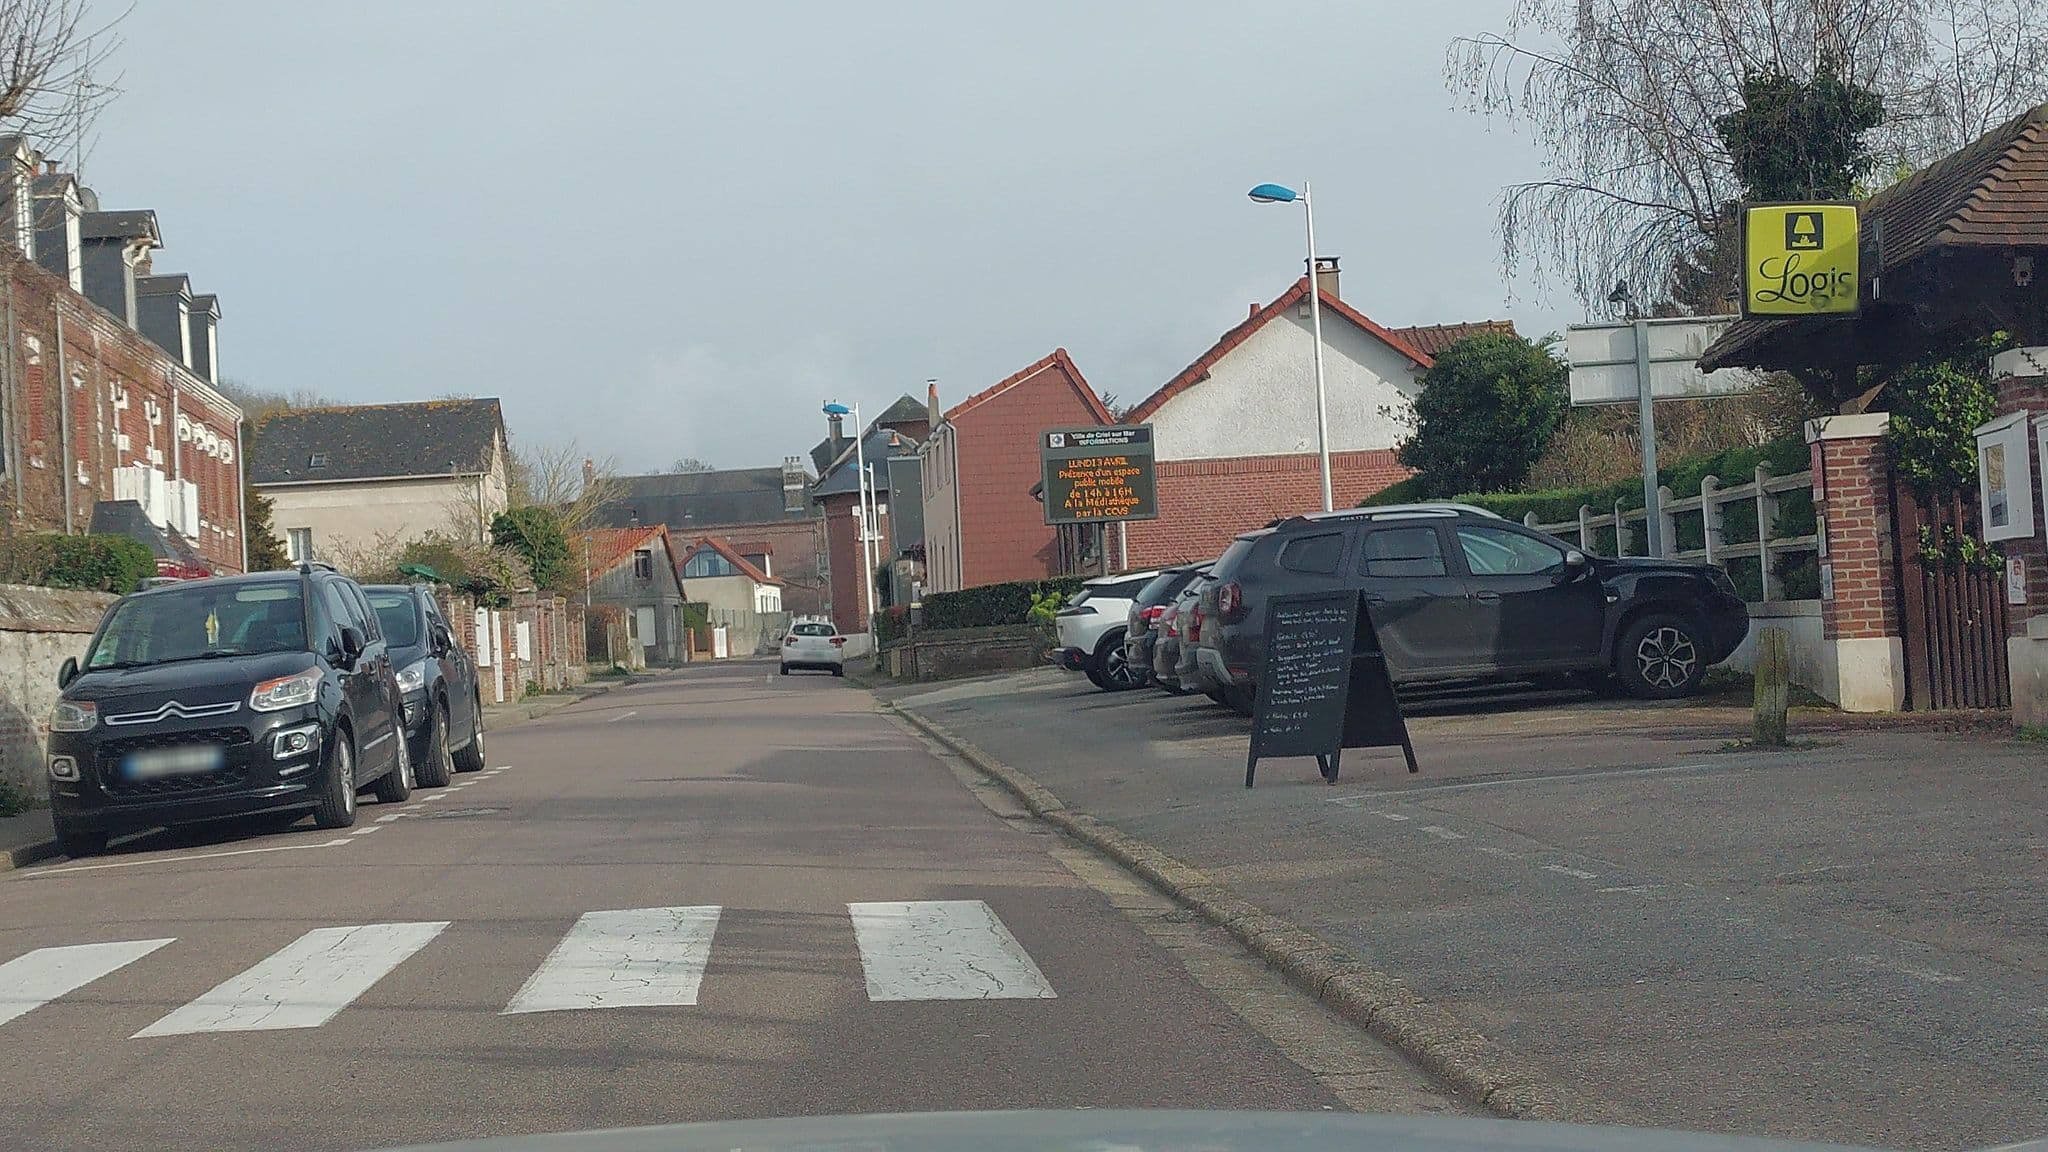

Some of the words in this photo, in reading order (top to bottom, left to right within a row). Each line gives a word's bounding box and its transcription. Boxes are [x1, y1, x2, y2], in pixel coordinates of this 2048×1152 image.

[1755, 253, 1853, 308] Logis
[1071, 432, 1086, 440] Ville
[1079, 438, 1129, 446] INFORMATIONS
[1068, 458, 1096, 468] LUNDI
[1059, 469, 1094, 479] Présence
[1095, 468, 1112, 477] d'un
[1113, 468, 1140, 477] espace
[1074, 478, 1096, 488] public
[1098, 477, 1124, 486] mobile
[1070, 489, 1081, 499] de
[1084, 488, 1101, 498] 14h
[1104, 487, 1110, 497] à
[1113, 486, 1132, 497] 16H
[1064, 499, 1072, 509] A
[1074, 499, 1083, 508] la
[1075, 509, 1091, 519] par
[1093, 507, 1102, 517] la
[1104, 507, 1129, 516] CCVS
